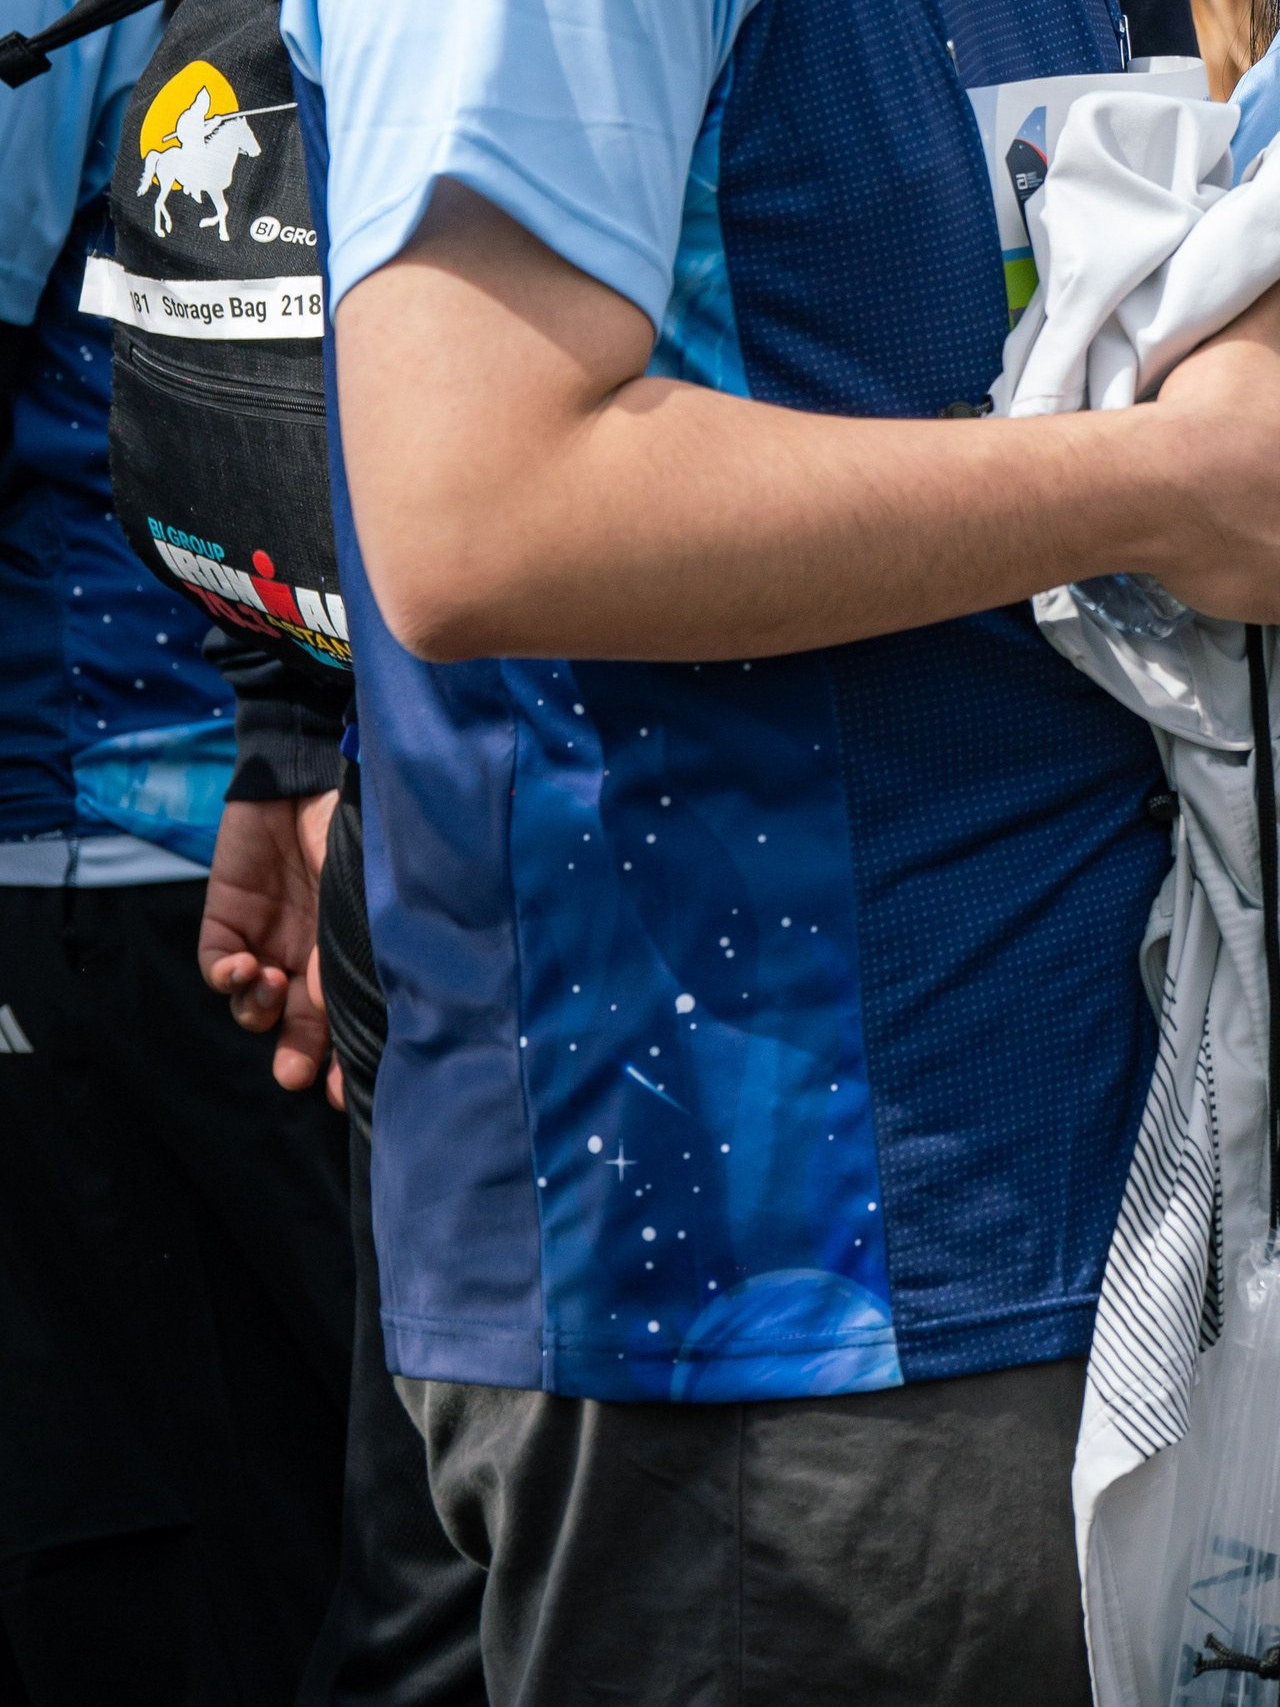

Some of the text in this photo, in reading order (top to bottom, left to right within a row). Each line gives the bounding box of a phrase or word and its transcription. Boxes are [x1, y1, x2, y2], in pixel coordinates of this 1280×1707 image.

[280, 227, 317, 246] GRO
[162, 295, 224, 324] Storage
[229, 297, 267, 323] Bag
[281, 294, 321, 317] 218
[147, 516, 225, 562] BI GROUP
[266, 613, 352, 658] ASTAN
